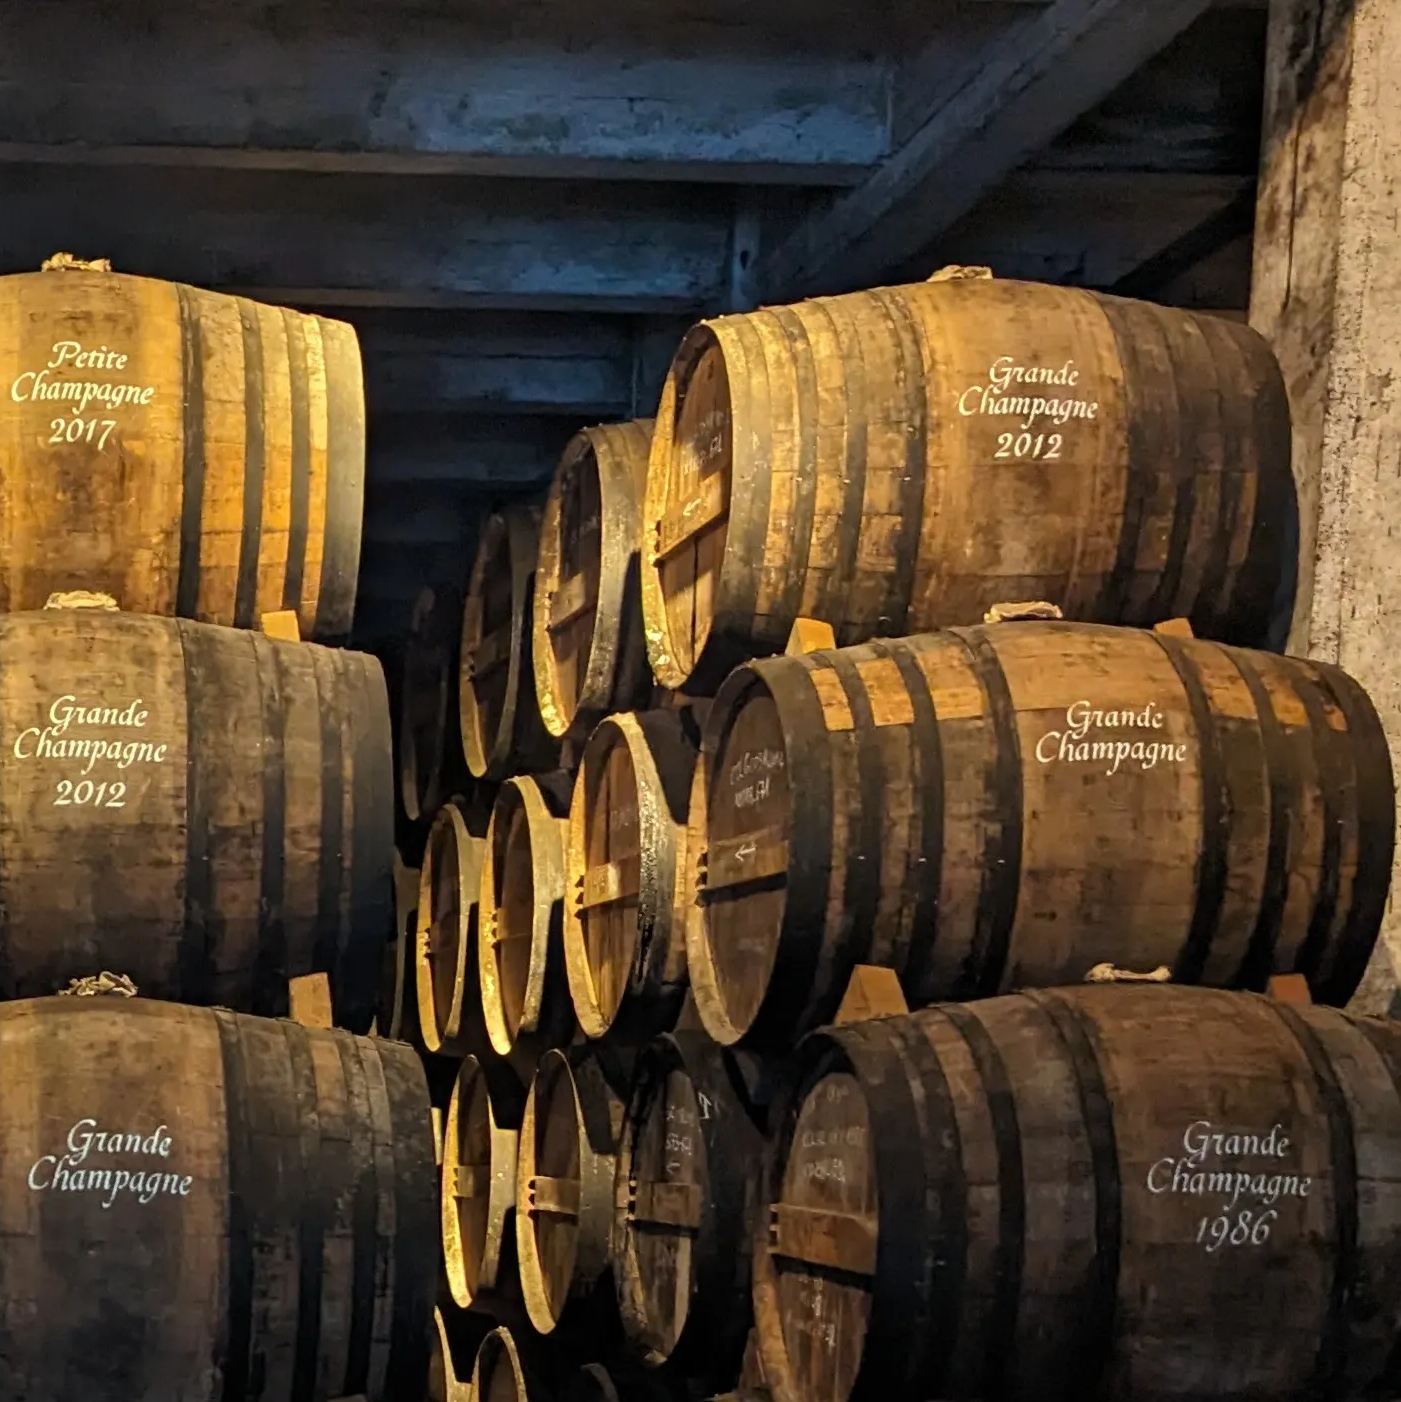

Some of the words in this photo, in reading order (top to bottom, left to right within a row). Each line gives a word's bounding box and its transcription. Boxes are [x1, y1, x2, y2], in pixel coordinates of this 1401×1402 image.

[48, 341, 128, 370] Petite
[989, 356, 1080, 394] Grande
[11, 370, 155, 414] Champagne
[958, 384, 1099, 429] Champagne
[49, 418, 116, 450] 2017
[994, 433, 1062, 459] 2012
[49, 695, 149, 736] Grande
[1066, 700, 1163, 739] Grande
[14, 727, 168, 775] Champagne
[1036, 730, 1187, 776] Champagne
[53, 780, 127, 808] 2012
[67, 1119, 173, 1166] Grande
[1183, 1121, 1290, 1168] Grande
[28, 1154, 193, 1208] Champagne
[1147, 1157, 1312, 1211] Champagne
[1197, 1210, 1278, 1252] 1986
